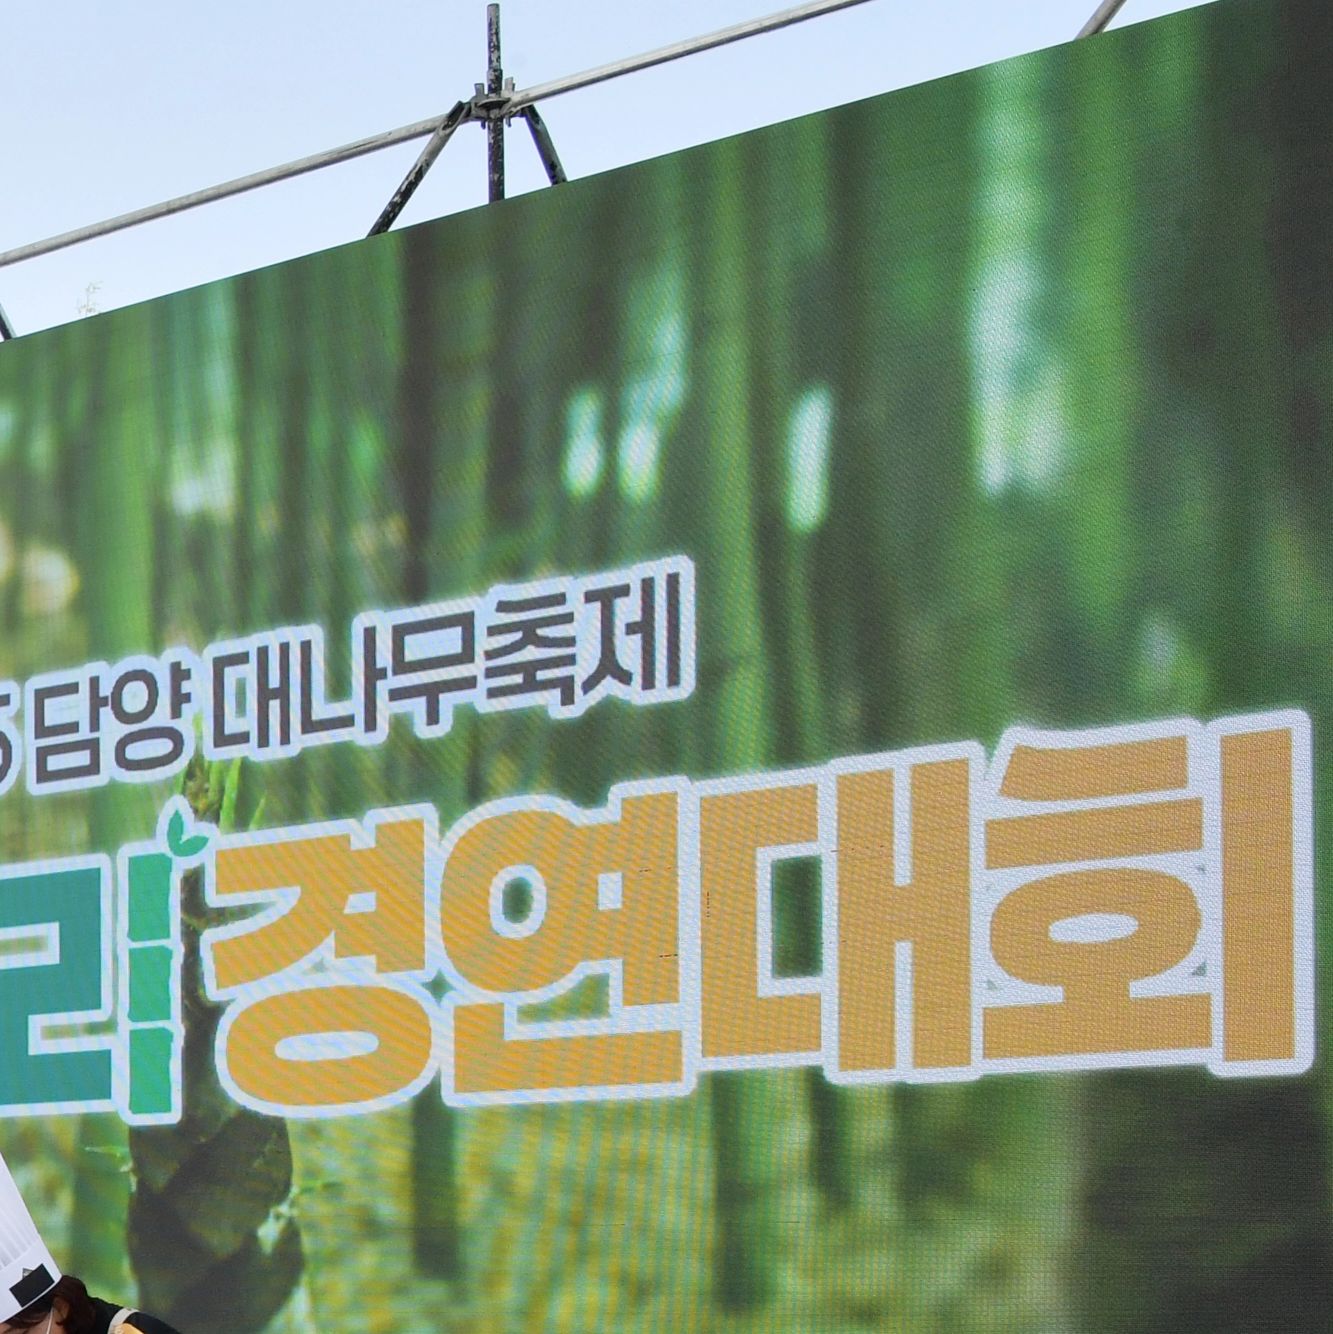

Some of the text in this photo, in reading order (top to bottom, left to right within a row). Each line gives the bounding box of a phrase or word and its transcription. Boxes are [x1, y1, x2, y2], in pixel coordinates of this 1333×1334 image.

[32, 658, 195, 787] 담양
[210, 570, 683, 750] 대나무축제
[206, 722, 1296, 1110] 경연대회
